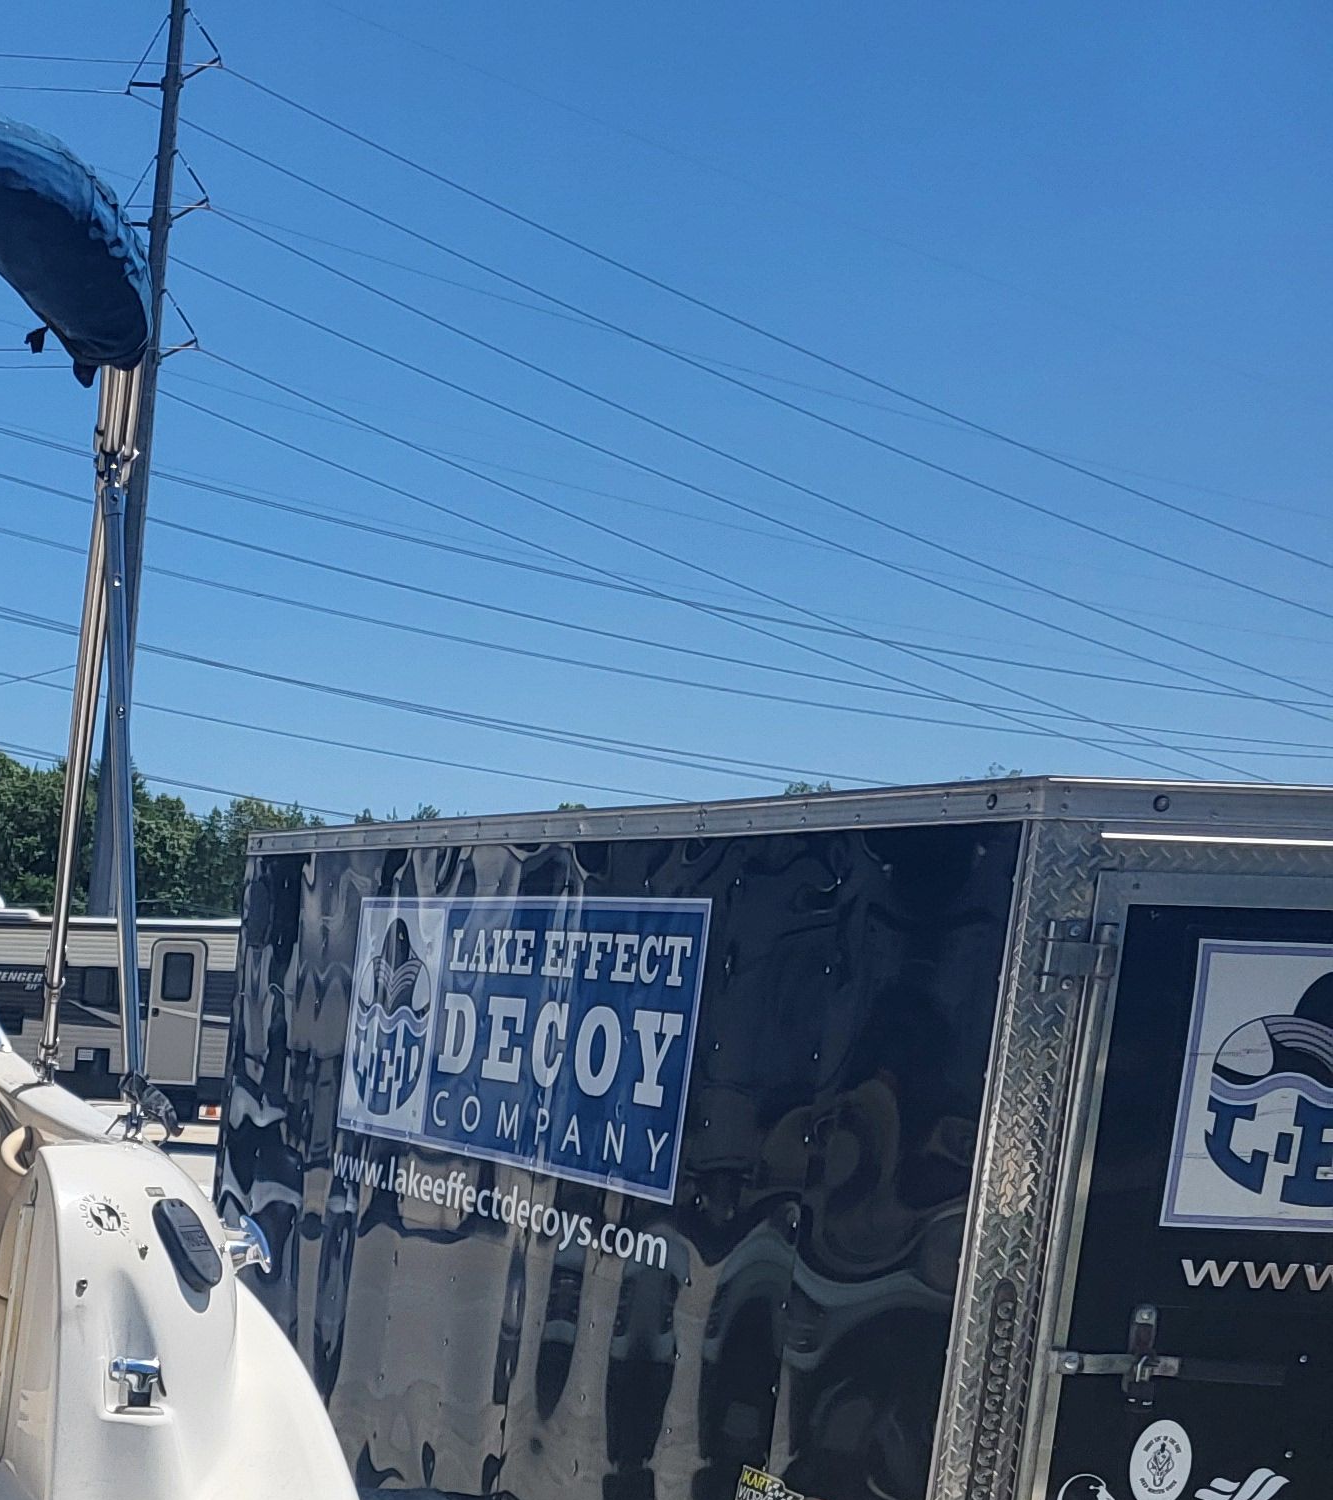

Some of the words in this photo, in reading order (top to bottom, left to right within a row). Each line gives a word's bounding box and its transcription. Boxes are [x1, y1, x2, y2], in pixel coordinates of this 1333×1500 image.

[448, 928, 535, 976] LAKE
[540, 930, 693, 988] EFFECT
[438, 992, 683, 1109] DECOY
[431, 1090, 670, 1174] COMPANY
[332, 1150, 668, 1270] www.lakeeffectdecoys.com
[742, 1470, 772, 1492] KART
